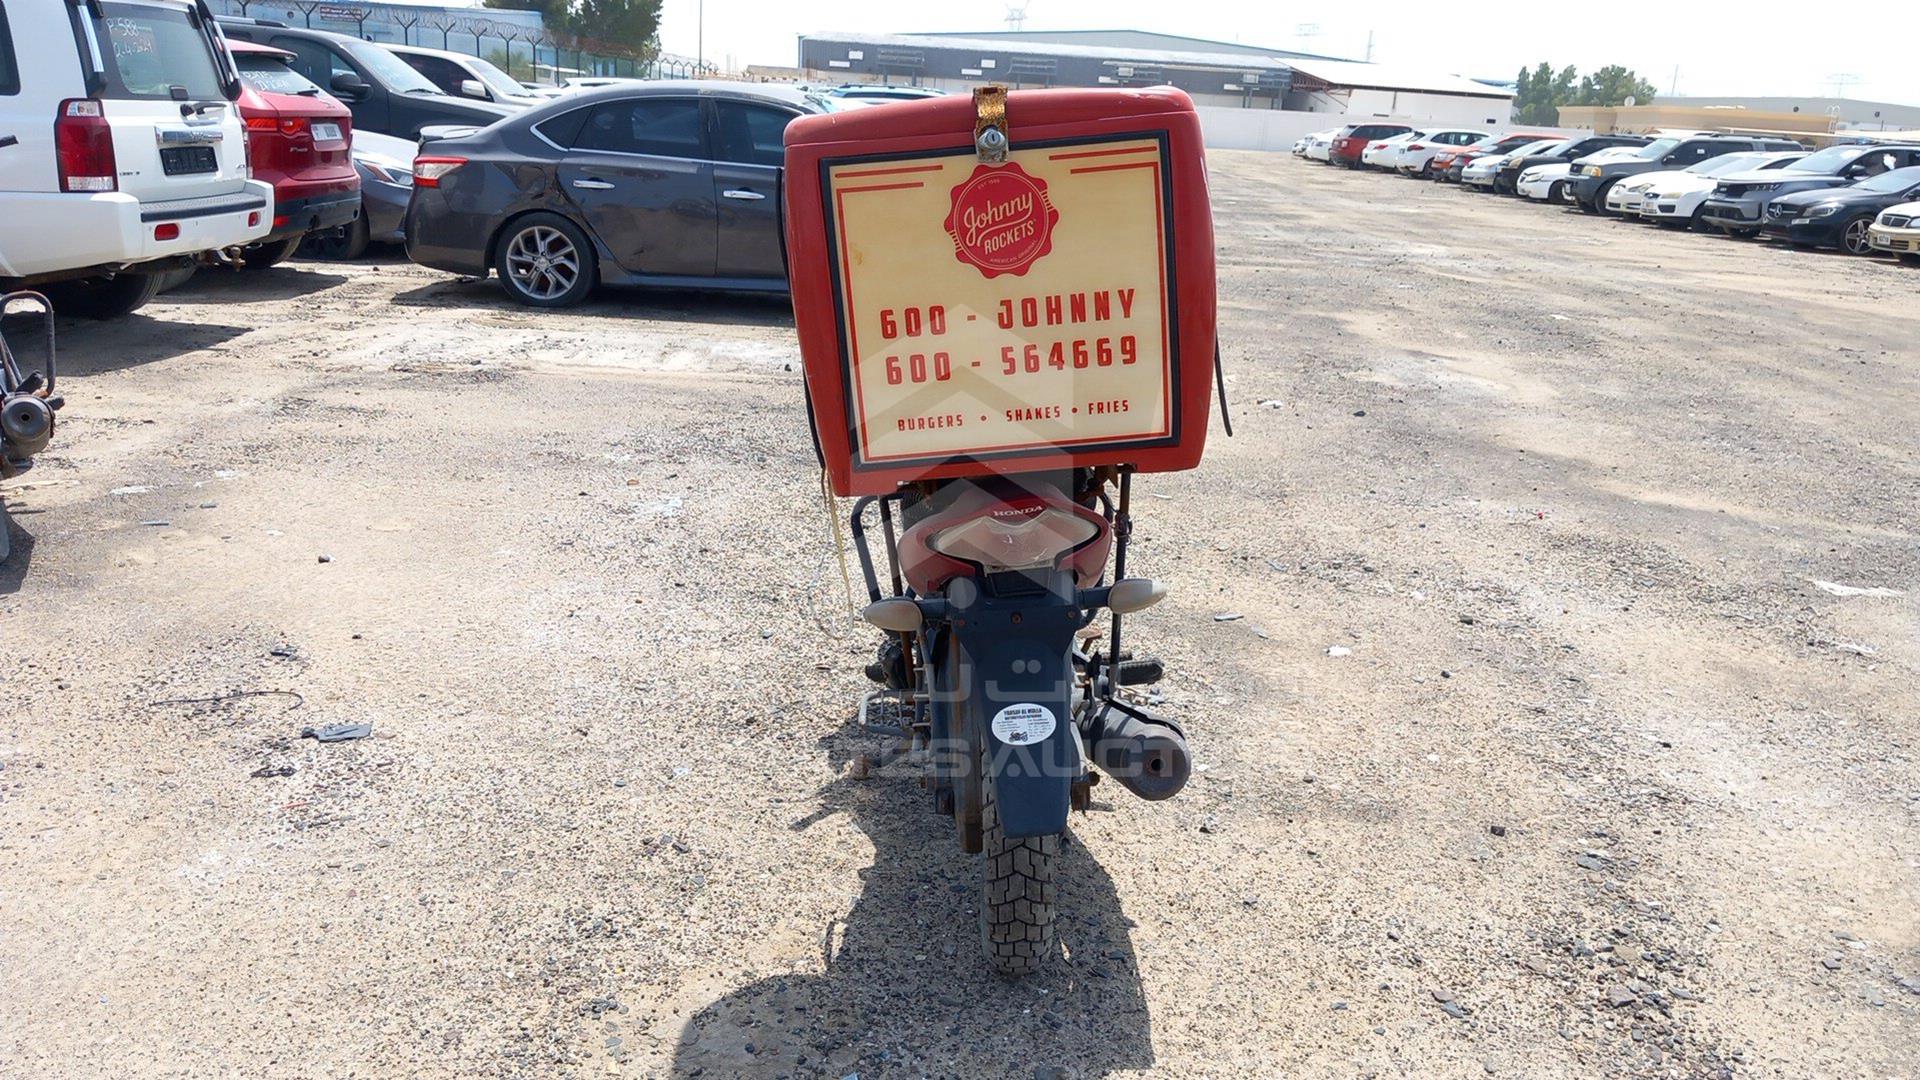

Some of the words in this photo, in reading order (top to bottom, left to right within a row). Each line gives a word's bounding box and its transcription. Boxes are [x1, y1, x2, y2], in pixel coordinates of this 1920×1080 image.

[963, 192, 1033, 247] Johnny
[984, 220, 1034, 255] ROCKETS
[880, 305, 946, 339] 600
[998, 288, 1135, 330] JOHNNY
[885, 352, 951, 385] 600
[1001, 335, 1137, 375] 564669
[897, 414, 964, 431] BURGERS
[1006, 405, 1061, 422] SHAKES
[1088, 399, 1130, 415] FRIES
[993, 505, 1043, 516] HONDA
